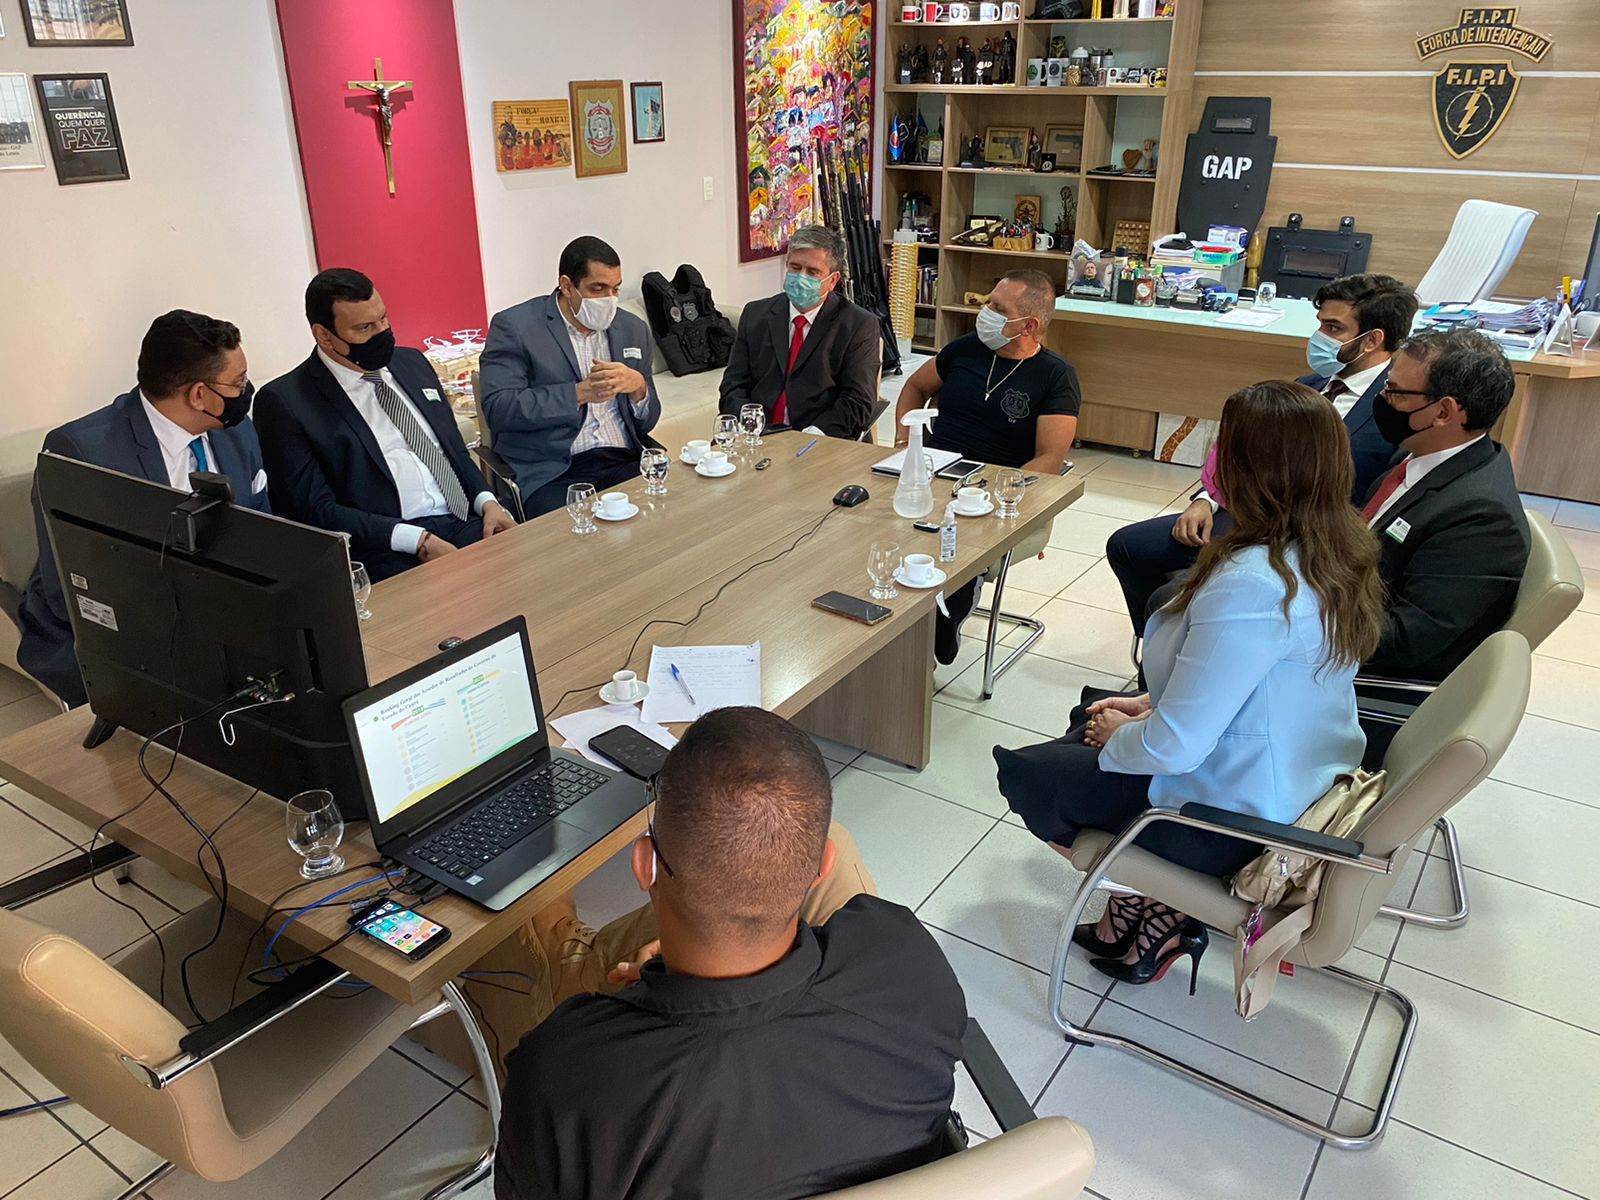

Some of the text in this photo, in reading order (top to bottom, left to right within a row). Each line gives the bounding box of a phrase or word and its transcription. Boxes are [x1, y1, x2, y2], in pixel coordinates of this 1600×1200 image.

[1462, 10, 1514, 24] F.I.P.I
[1421, 32, 1459, 54] FORÇA
[1461, 28, 1475, 43] DE
[1446, 69, 1506, 85] F.I.P.I
[55, 110, 106, 120] QUERÊNCIA:
[58, 118, 106, 128] QUEM QUER
[60, 127, 111, 150] FAZ
[1202, 154, 1253, 180] GAP
